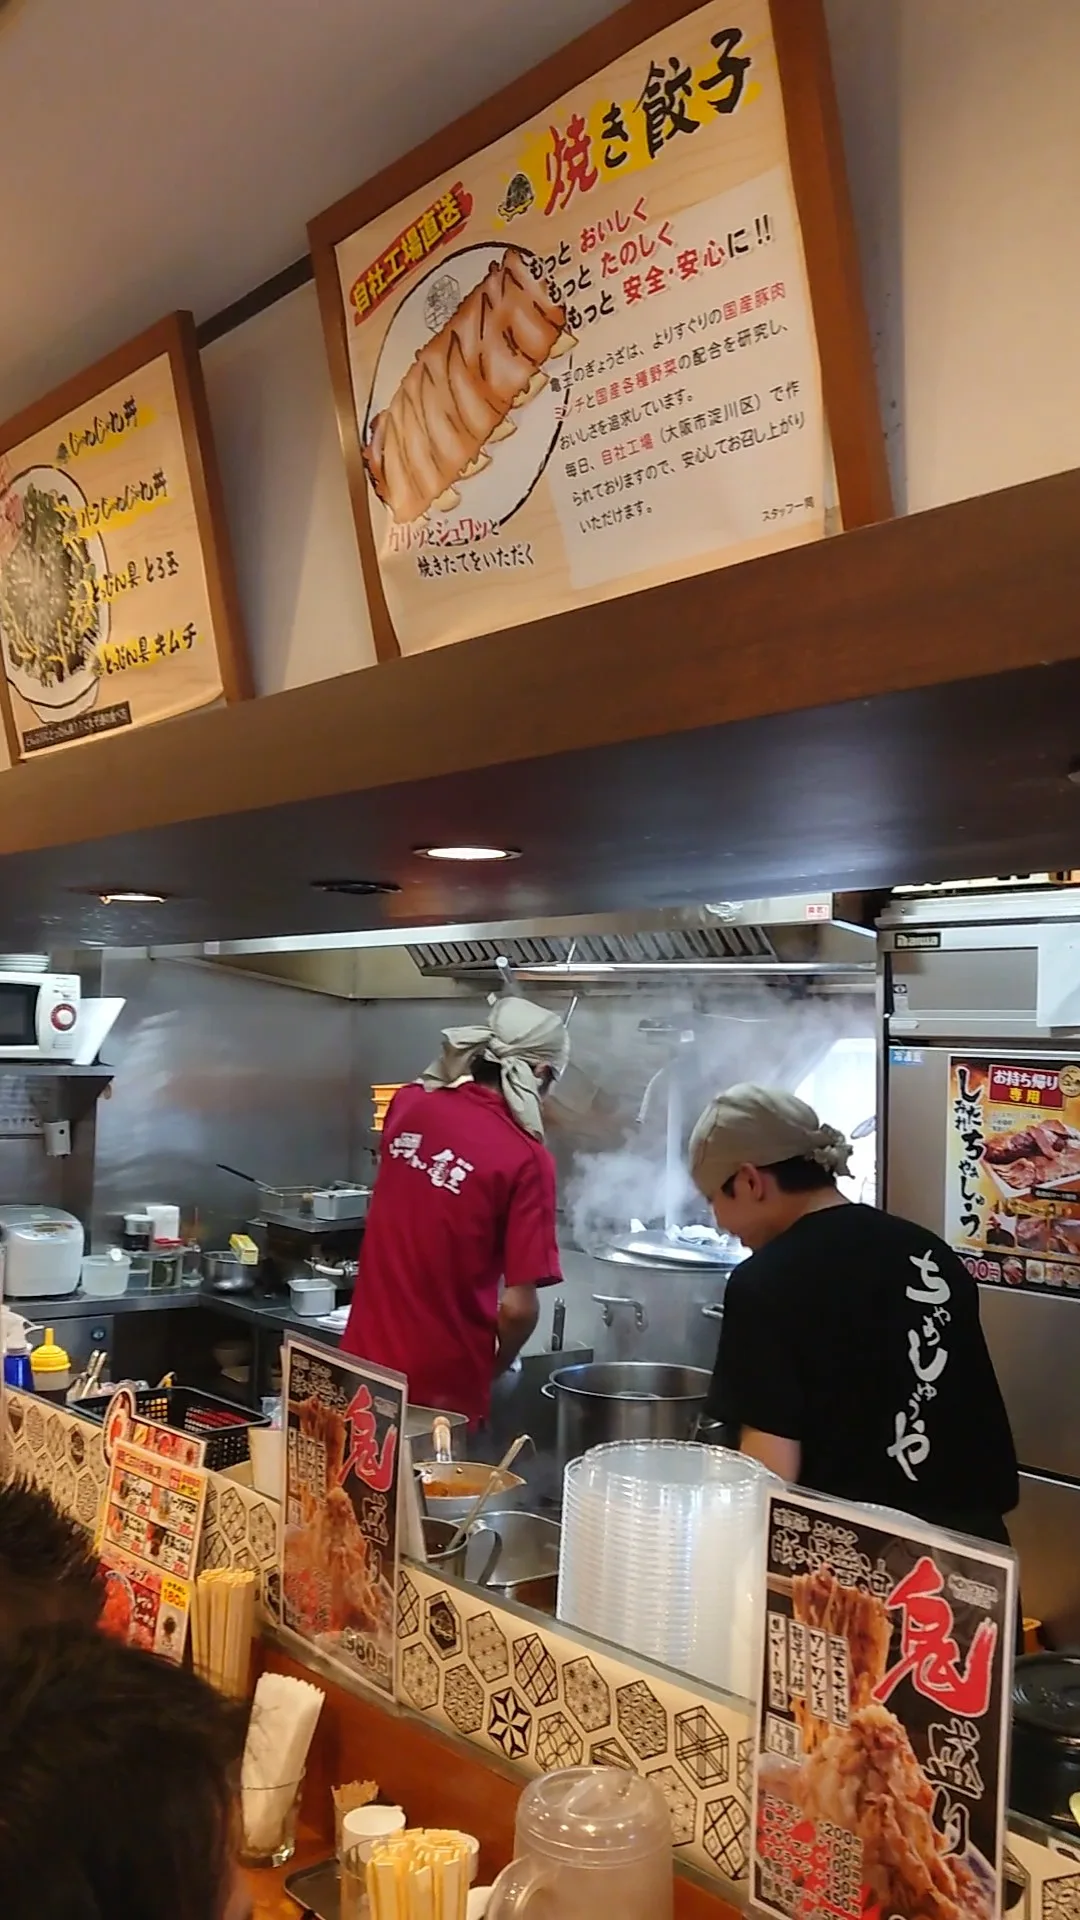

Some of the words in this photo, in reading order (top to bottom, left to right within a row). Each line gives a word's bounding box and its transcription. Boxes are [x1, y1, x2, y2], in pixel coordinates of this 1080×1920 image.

[544, 27, 751, 216] 焼き餃子
[353, 192, 461, 314] 自社工場直送
[529, 241, 572, 280] もっと
[580, 197, 648, 252] おいしく
[548, 264, 592, 304] もっと
[601, 221, 674, 278] たのしく
[566, 290, 614, 331] もっと
[579, 500, 652, 533] いただけます。
[417, 544, 534, 577] 焼きたてをいただく
[993, 1069, 1059, 1091] お持ち帰り
